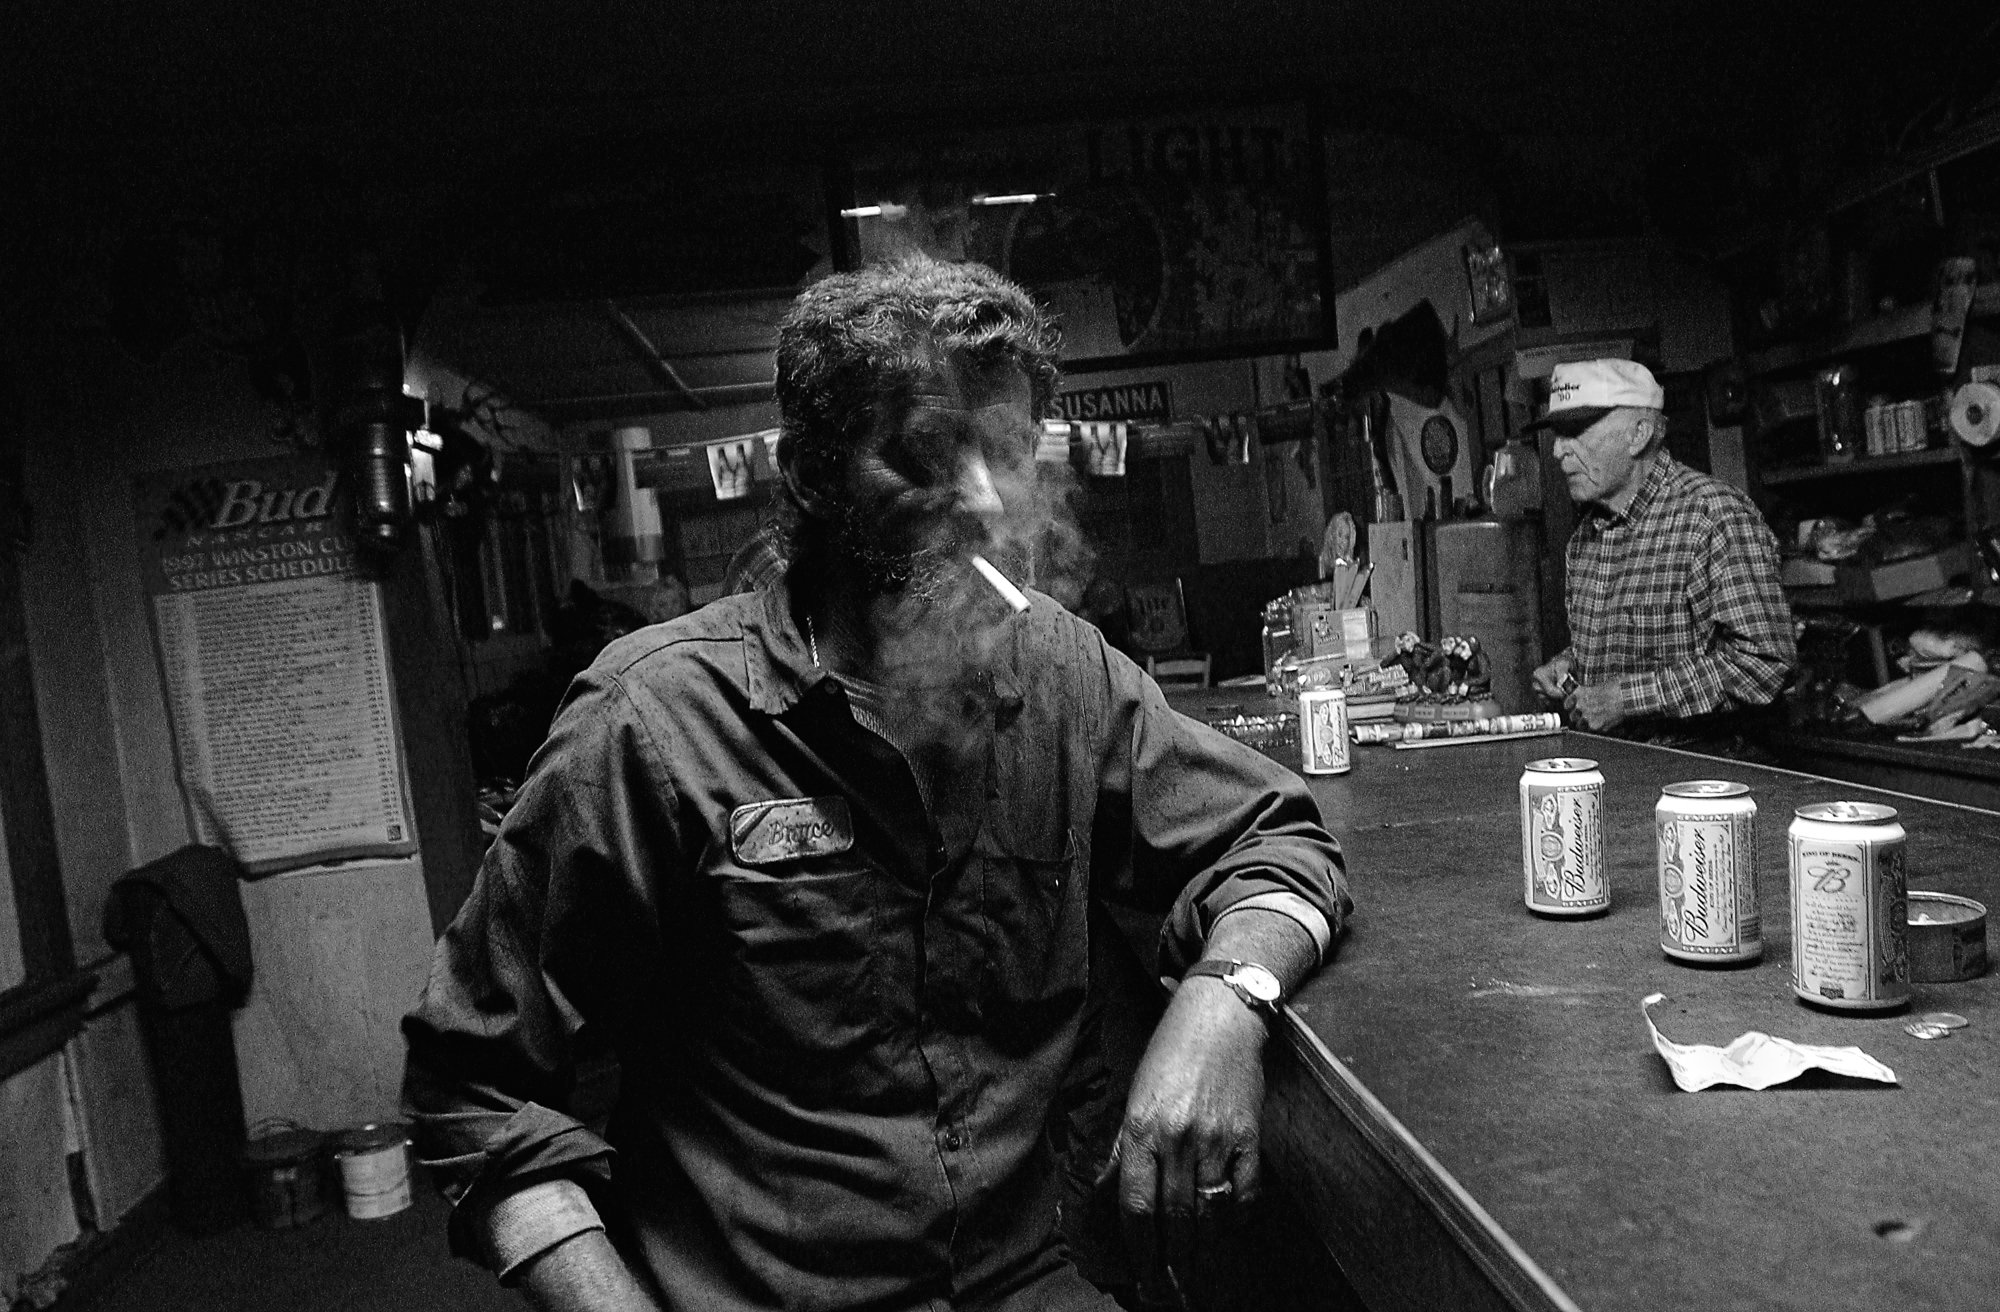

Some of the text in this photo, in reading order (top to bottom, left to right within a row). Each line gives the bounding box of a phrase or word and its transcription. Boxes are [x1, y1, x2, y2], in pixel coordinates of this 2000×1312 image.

[1087, 124, 1284, 185] LIGHT
[1049, 385, 1164, 419] SUSANNA
[208, 470, 339, 529] Bud
[169, 553, 355, 592] SERIES SCHEDULE
[211, 539, 315, 567] WINSTON
[1563, 798, 1585, 898] Budweiser
[1684, 829, 1709, 942] Budweiser
